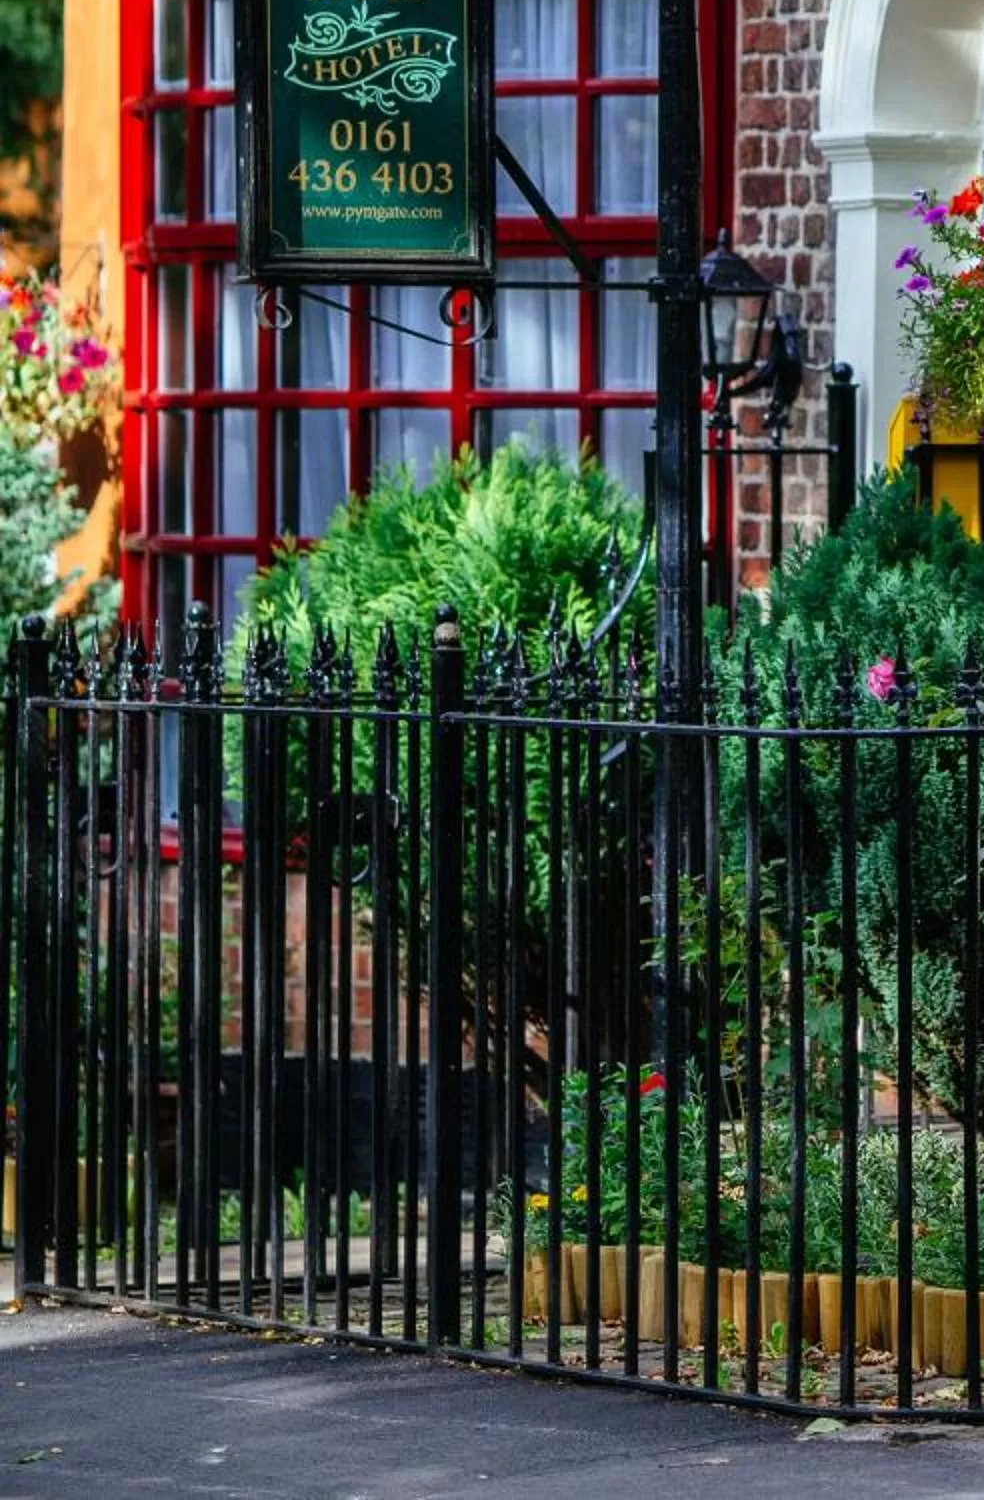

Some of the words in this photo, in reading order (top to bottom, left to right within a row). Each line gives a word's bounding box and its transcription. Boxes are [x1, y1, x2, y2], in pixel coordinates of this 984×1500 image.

[313, 33, 432, 84] HOTEL
[329, 118, 412, 153] 0161
[288, 159, 357, 193] 436
[371, 161, 454, 194] 4103
[301, 203, 443, 221] www.pymgate.com
